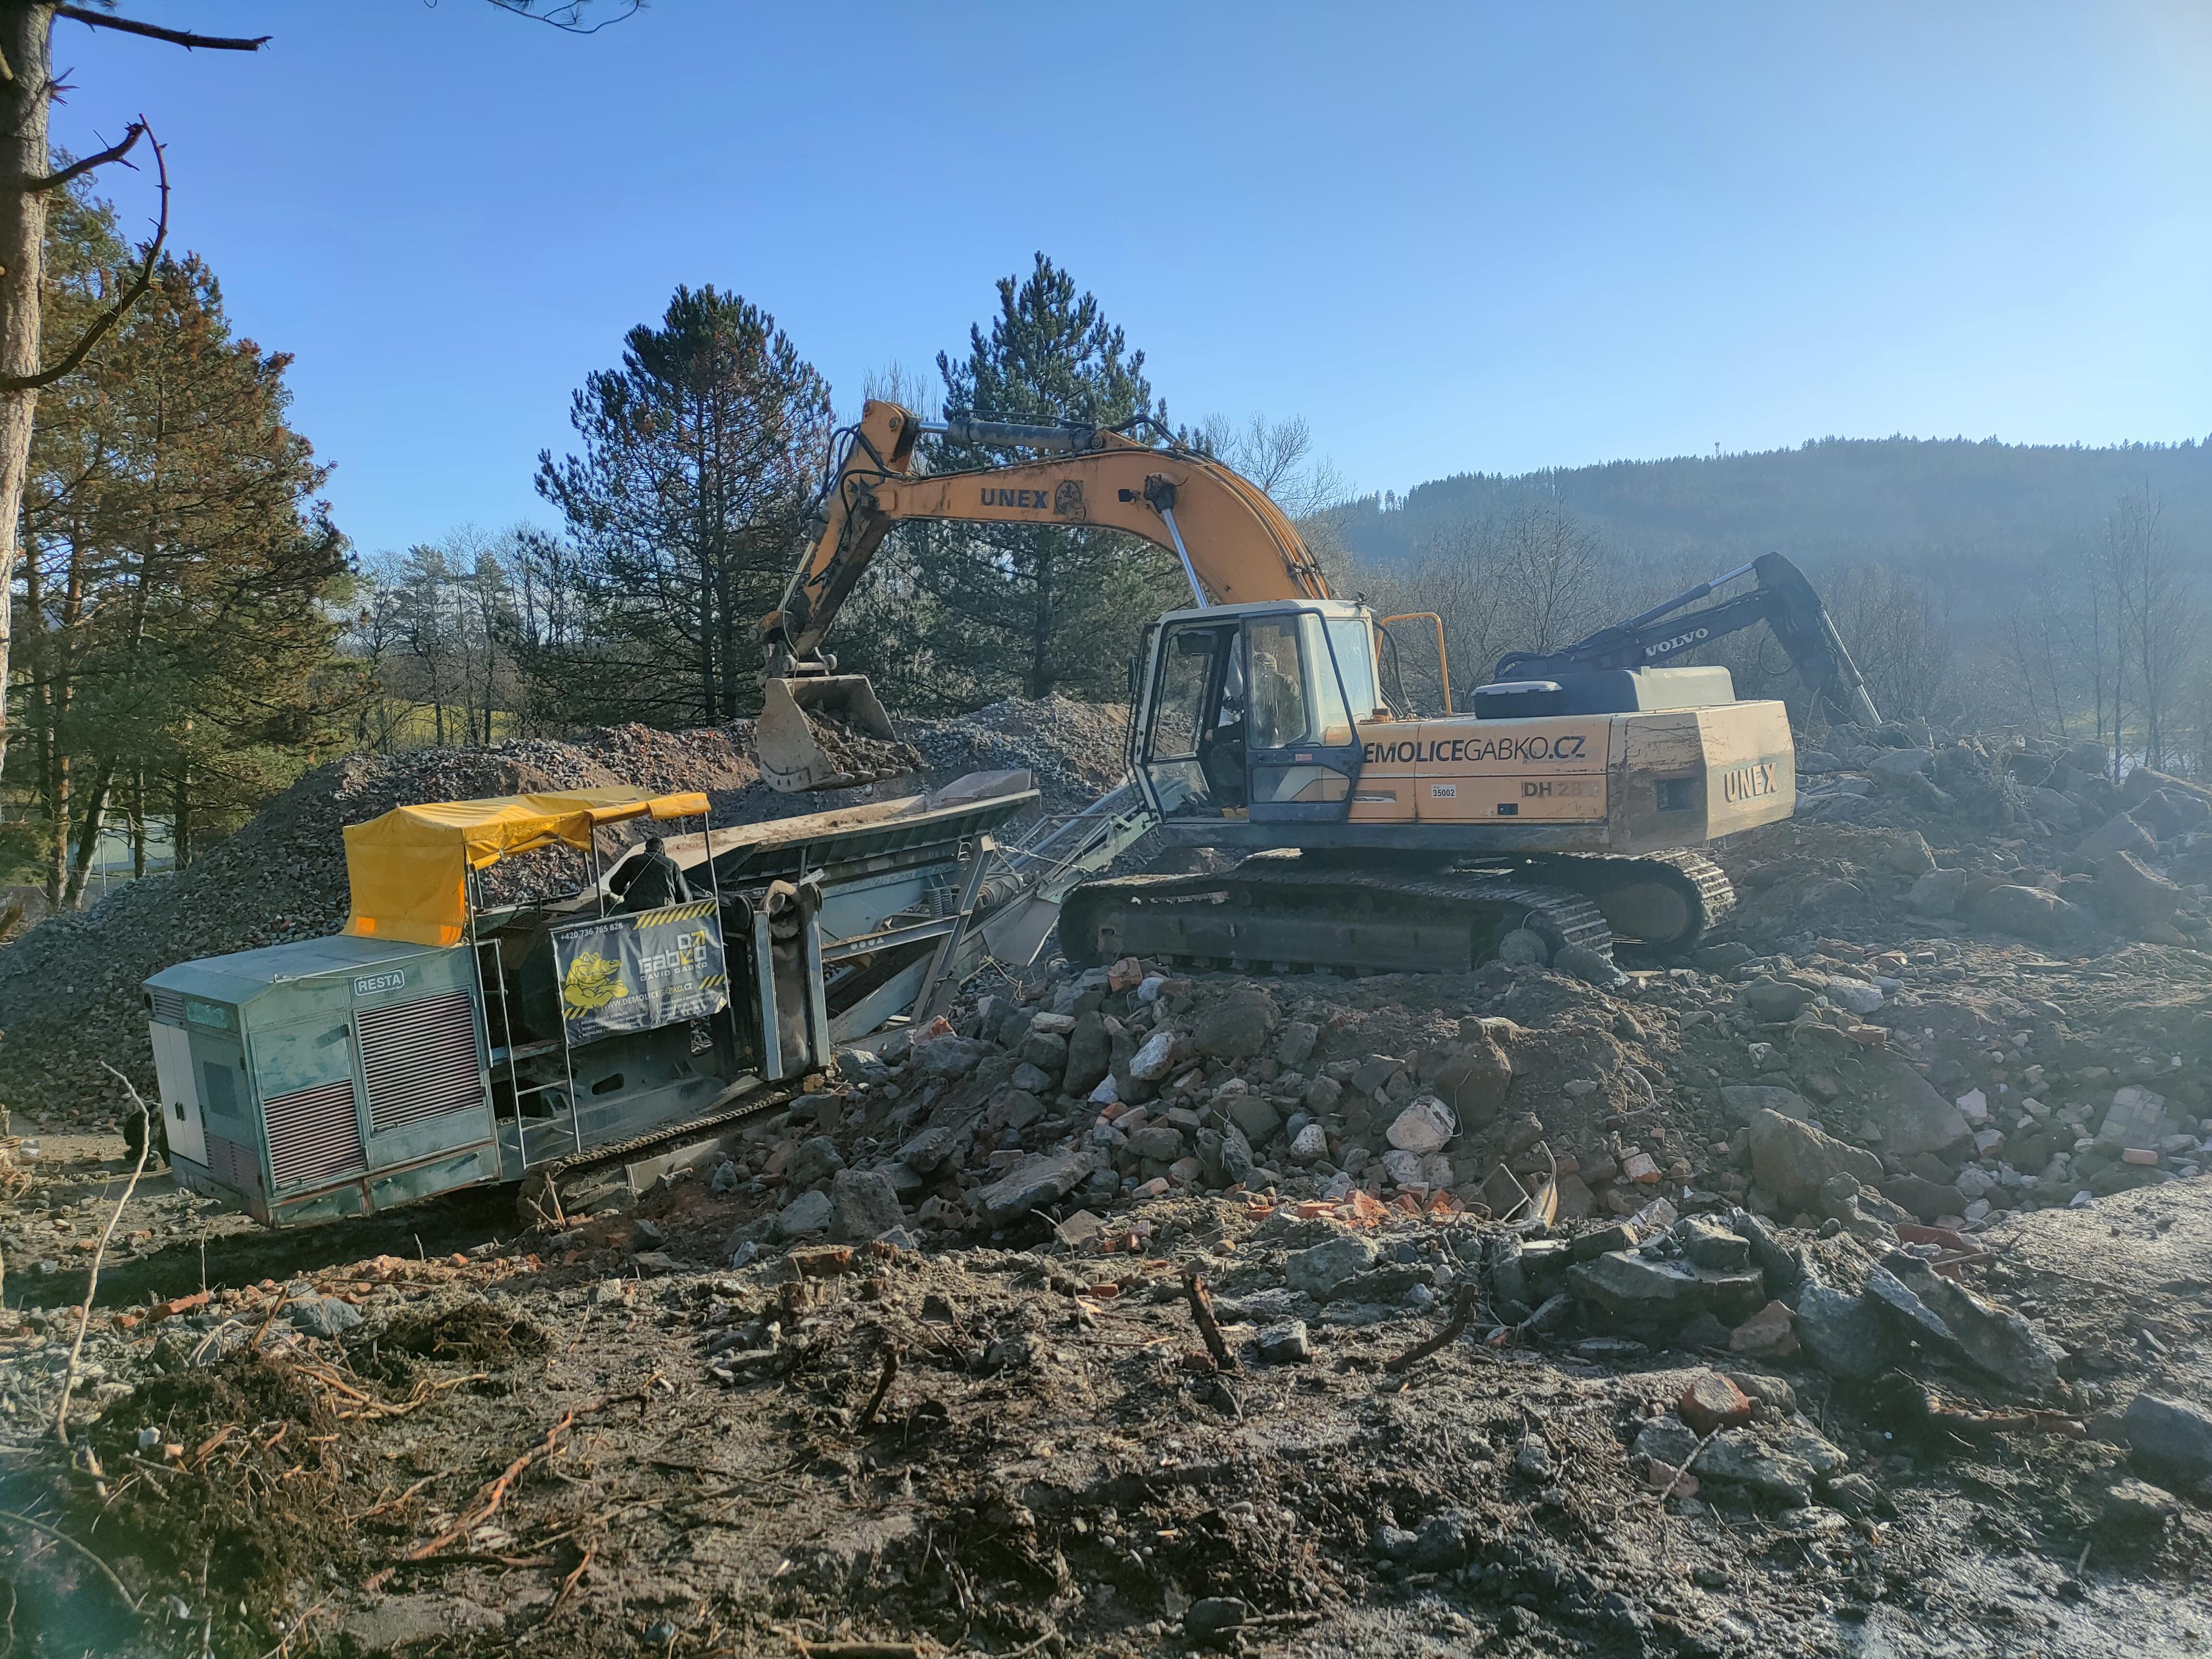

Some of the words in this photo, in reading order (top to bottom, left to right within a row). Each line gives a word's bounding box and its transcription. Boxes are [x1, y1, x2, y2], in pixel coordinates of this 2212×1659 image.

[981, 488, 1048, 509] UNEX
[1646, 628, 1708, 656] VOLVO
[1363, 735, 1587, 763] EMOLICEGABKO.CZ
[1524, 782, 1552, 796] DH
[1724, 763, 1778, 805] UNEX
[561, 931, 578, 940] +420
[580, 927, 593, 936] 736
[594, 925, 608, 933] 765
[609, 922, 623, 931] 828
[358, 974, 401, 992] RESTA
[640, 970, 670, 982] DAVID
